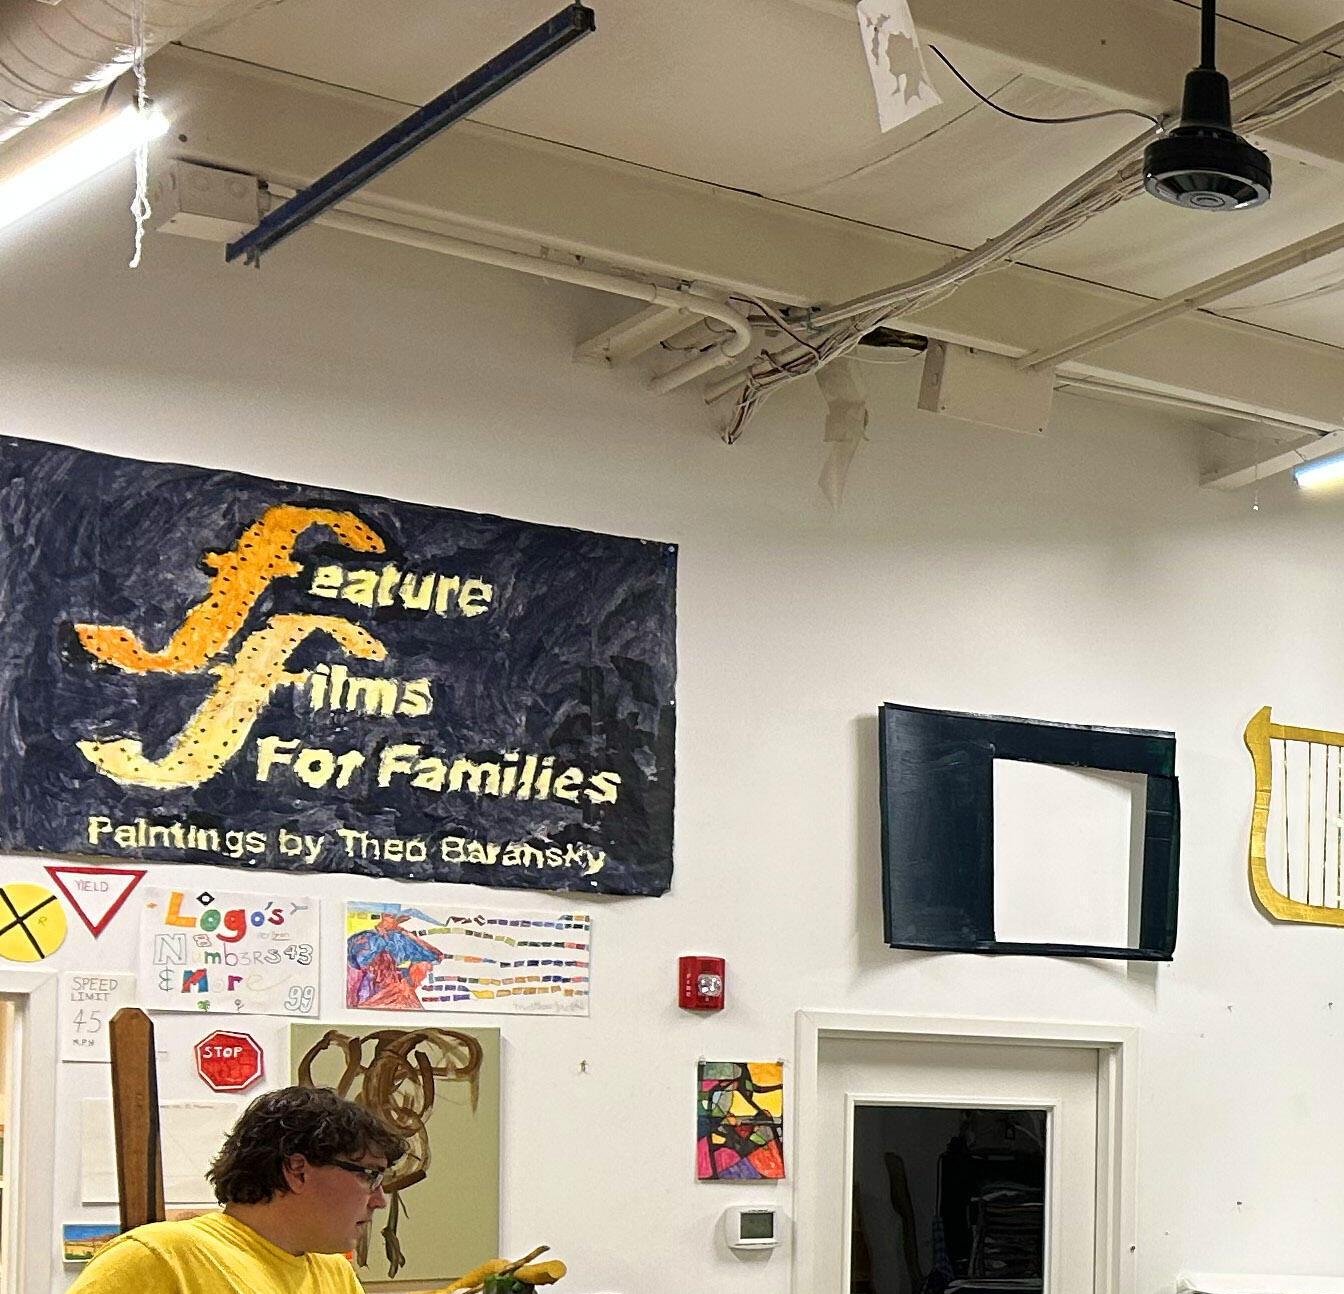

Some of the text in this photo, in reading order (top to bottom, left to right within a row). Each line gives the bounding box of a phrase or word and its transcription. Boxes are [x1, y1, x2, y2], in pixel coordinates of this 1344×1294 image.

[256, 735, 621, 804] For Families
[88, 815, 606, 873] Paintings by Theo Baransky
[74, 879, 109, 892] YIELD
[165, 891, 284, 943] Logo's
[70, 991, 111, 1002] LIMIT
[72, 976, 119, 992] SPEED
[284, 986, 316, 1013] 99
[72, 1009, 102, 1034] 45
[203, 1046, 243, 1059] STOP
